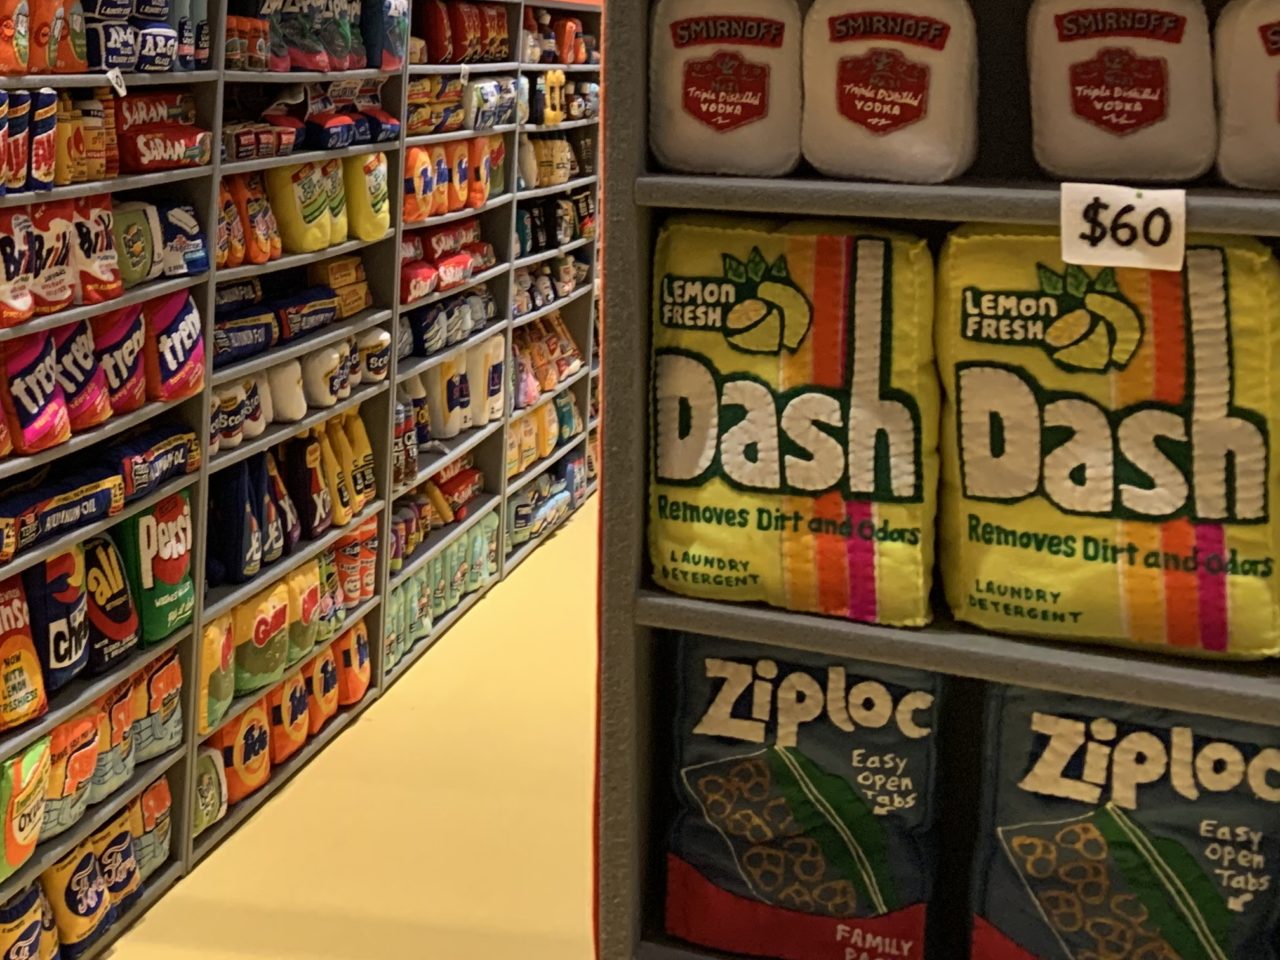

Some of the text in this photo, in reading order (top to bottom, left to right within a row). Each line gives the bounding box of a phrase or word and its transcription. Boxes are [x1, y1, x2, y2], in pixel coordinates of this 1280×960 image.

[676, 20, 782, 45] SMIRNOFF
[835, 16, 945, 42] SMIRNOFF
[1063, 12, 1176, 36] SMIRNOFF
[122, 101, 168, 130] SARAN
[700, 103, 742, 115] VODKA
[855, 100, 901, 115] VODKA
[137, 134, 185, 164] SARAN
[1078, 198, 1173, 247] $60
[662, 305, 722, 327] FRESH
[966, 315, 1045, 341] FRESH
[655, 237, 916, 498] Dash
[959, 249, 1268, 522] Dash
[657, 494, 751, 529] Removes
[757, 505, 803, 533] Dirt
[807, 515, 852, 538] and
[139, 498, 192, 589] Persi
[968, 513, 1077, 559] Removes
[1083, 535, 1139, 567] Dirt
[1143, 548, 1199, 574] and
[87, 542, 125, 607] all
[670, 550, 750, 572] LAUNDRY
[662, 566, 761, 588] DETERGENT
[975, 579, 1062, 605] LAUNDRY
[969, 594, 1085, 624] DETERGENT
[692, 657, 936, 747] Ziploc
[851, 750, 908, 778] Easy
[1018, 711, 1280, 809] Ziploc
[857, 770, 913, 792] Open
[863, 790, 919, 810] Tabs
[1199, 819, 1265, 851] Easy
[1204, 842, 1266, 869] Open
[1214, 868, 1271, 893] Tabs
[836, 924, 913, 956] FAMILY
